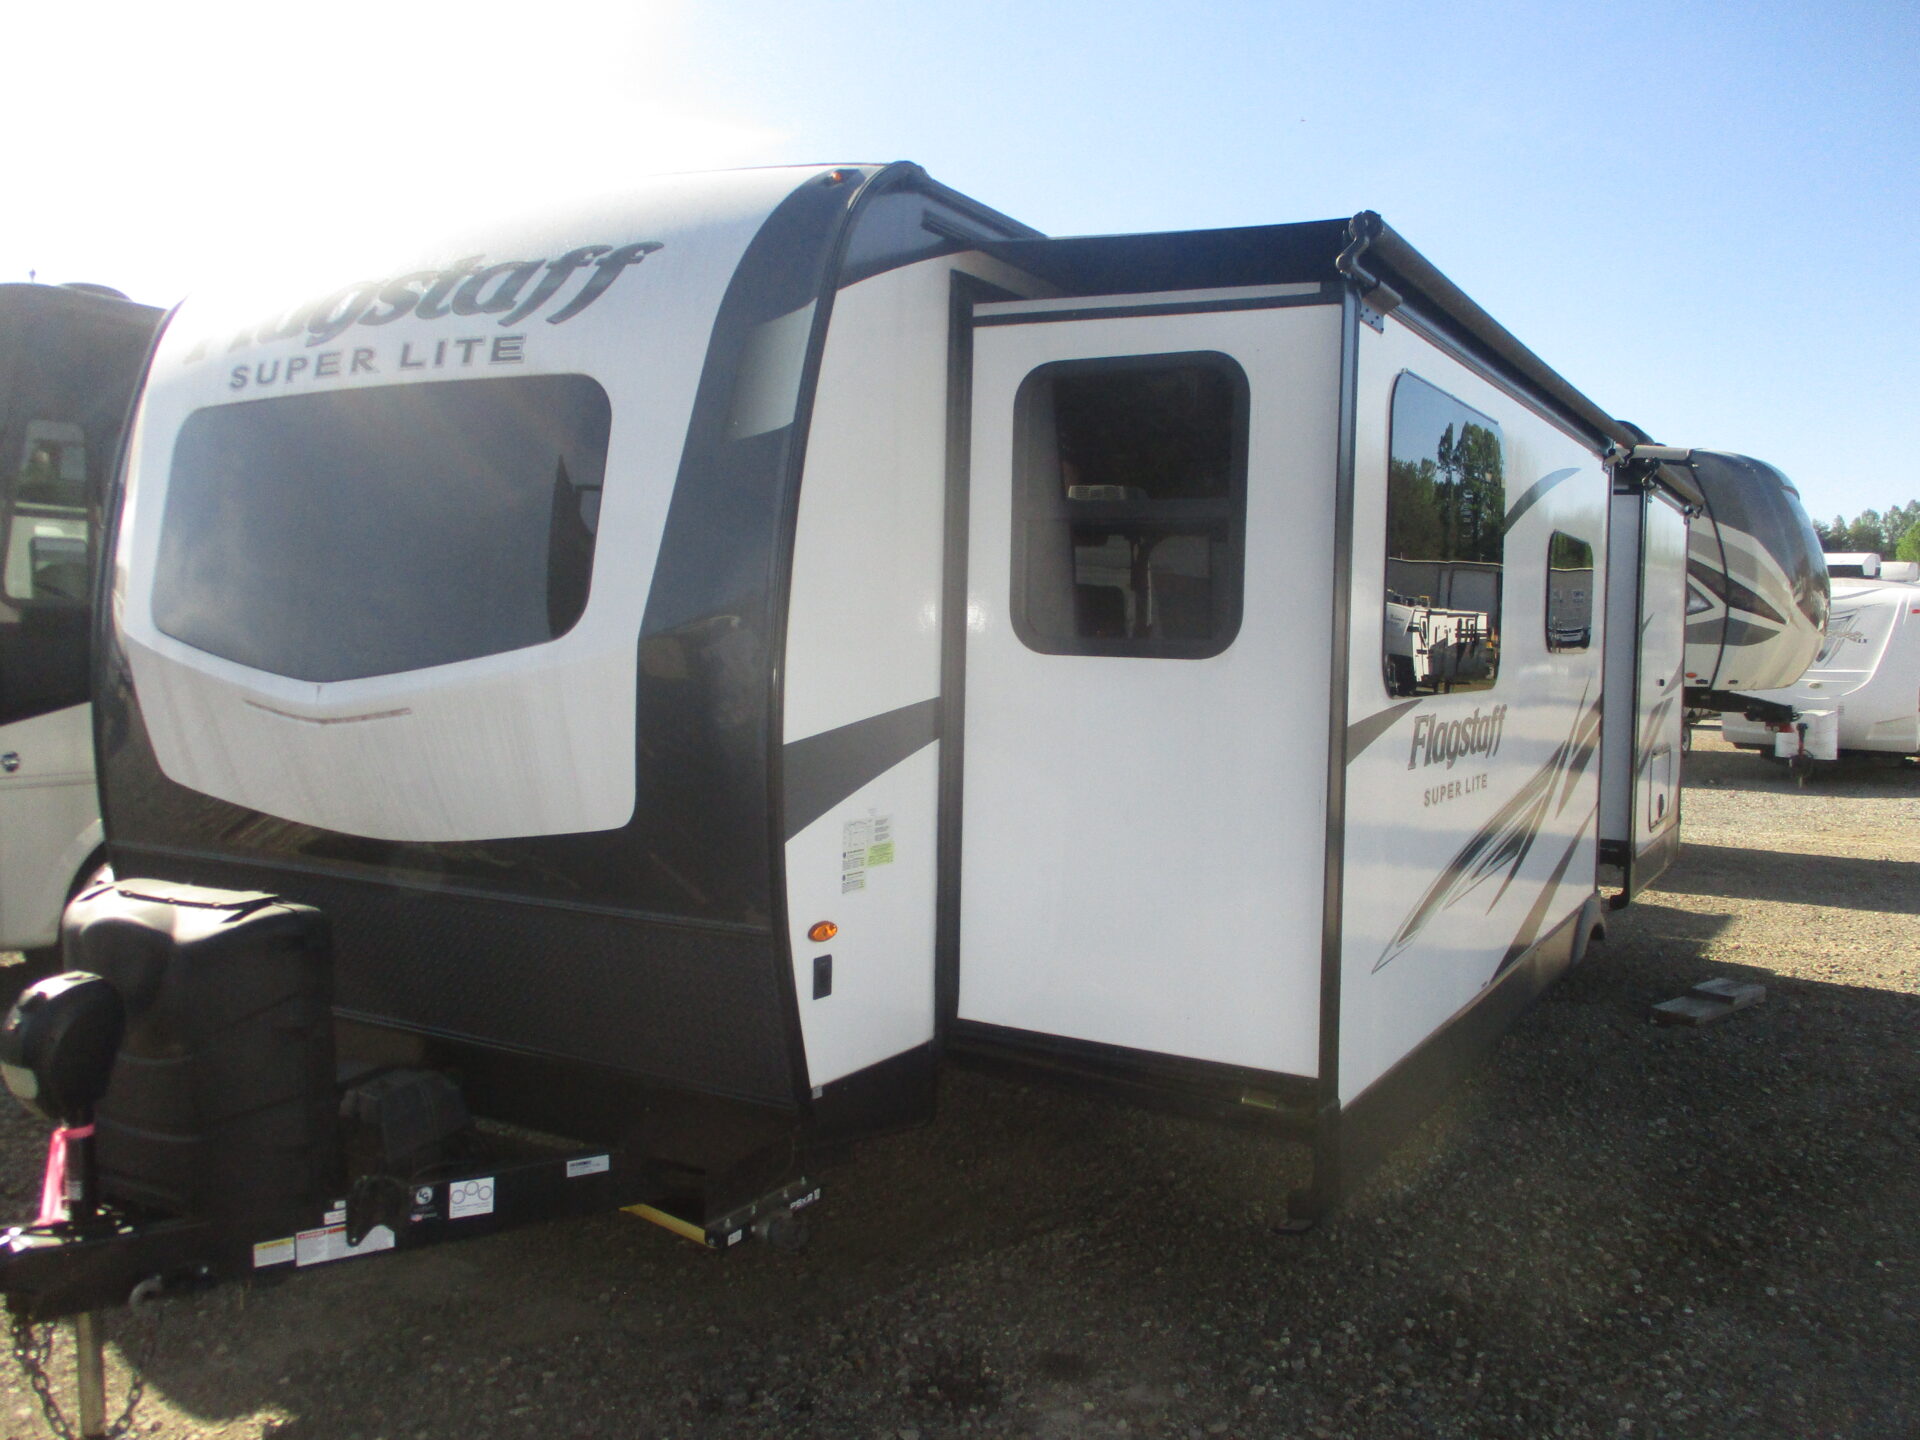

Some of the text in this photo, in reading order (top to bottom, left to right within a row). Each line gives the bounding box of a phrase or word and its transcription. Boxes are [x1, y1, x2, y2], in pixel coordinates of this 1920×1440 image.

[229, 332, 526, 390] SUPER LITE
[1407, 704, 1508, 770] Flagstaff
[1423, 773, 1488, 808] SUPER LITE
